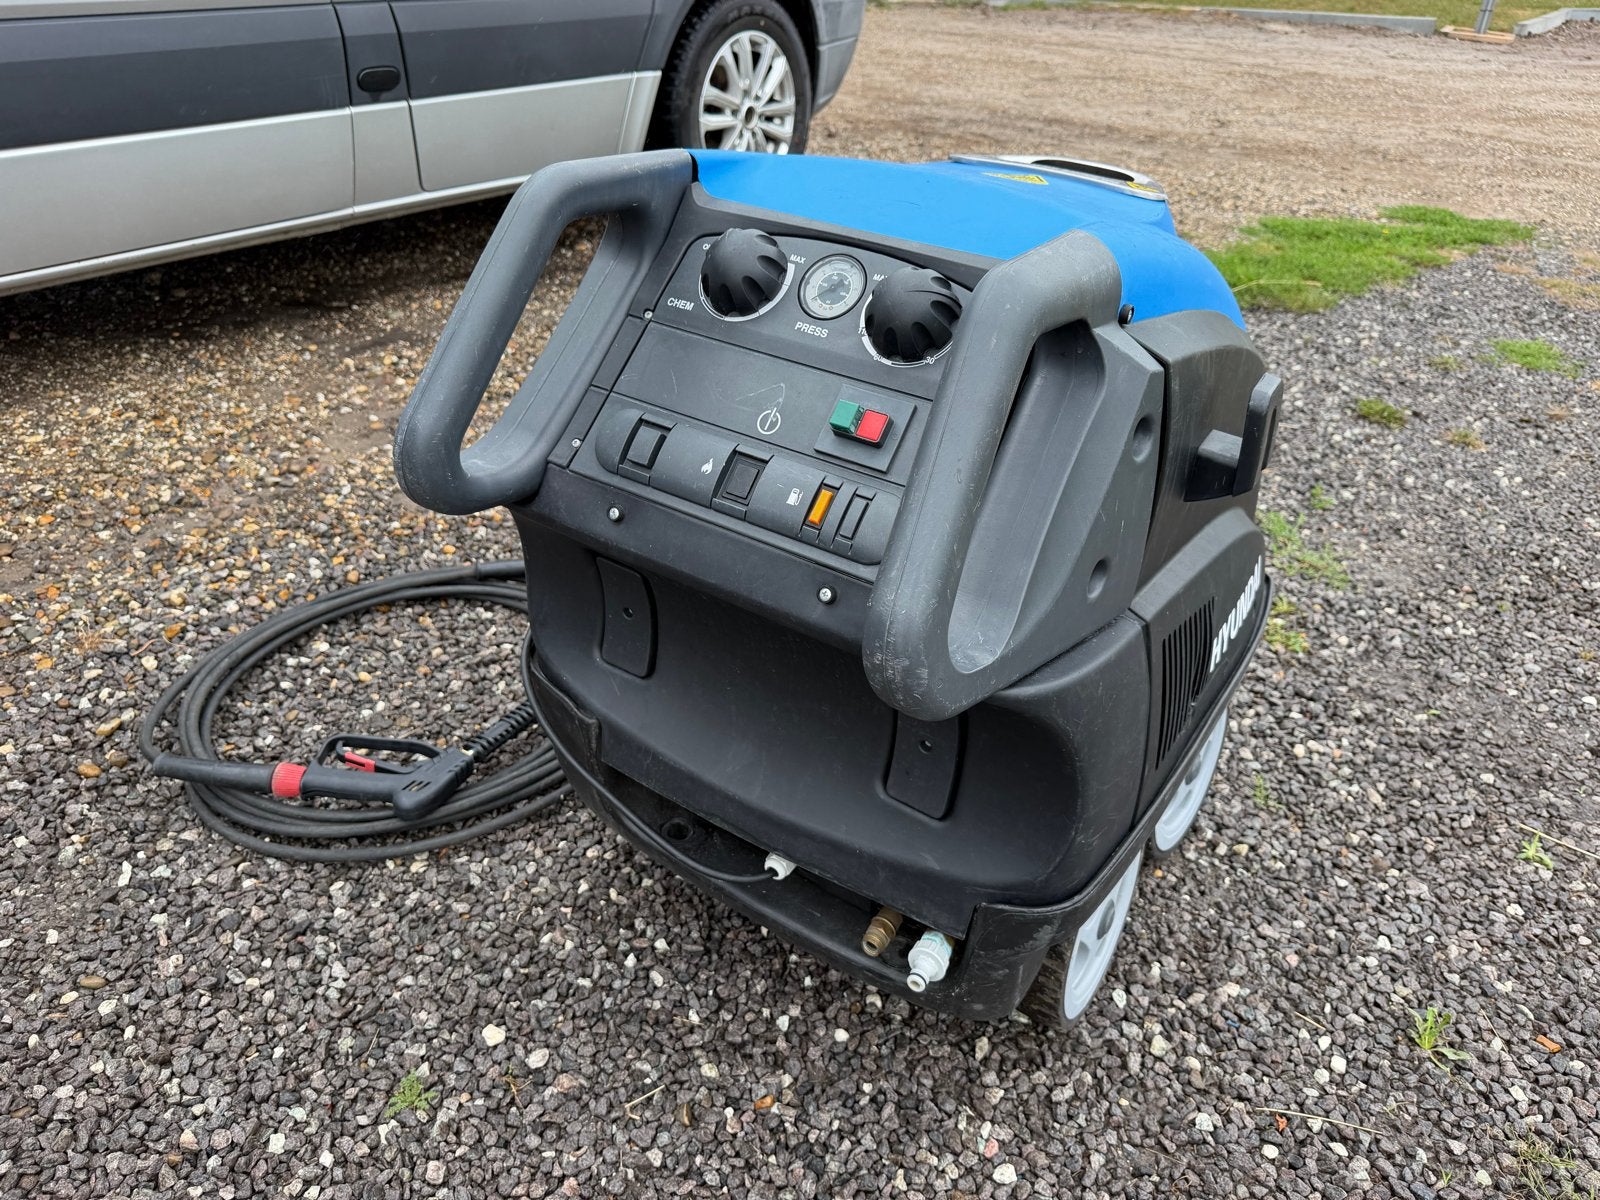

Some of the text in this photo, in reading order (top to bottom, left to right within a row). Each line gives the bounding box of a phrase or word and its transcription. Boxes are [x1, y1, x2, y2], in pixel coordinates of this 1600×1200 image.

[789, 253, 806, 264] MAX
[872, 273, 888, 282] MA
[667, 297, 695, 311] CHEM
[794, 321, 829, 338] PRESS
[925, 356, 935, 365] 30
